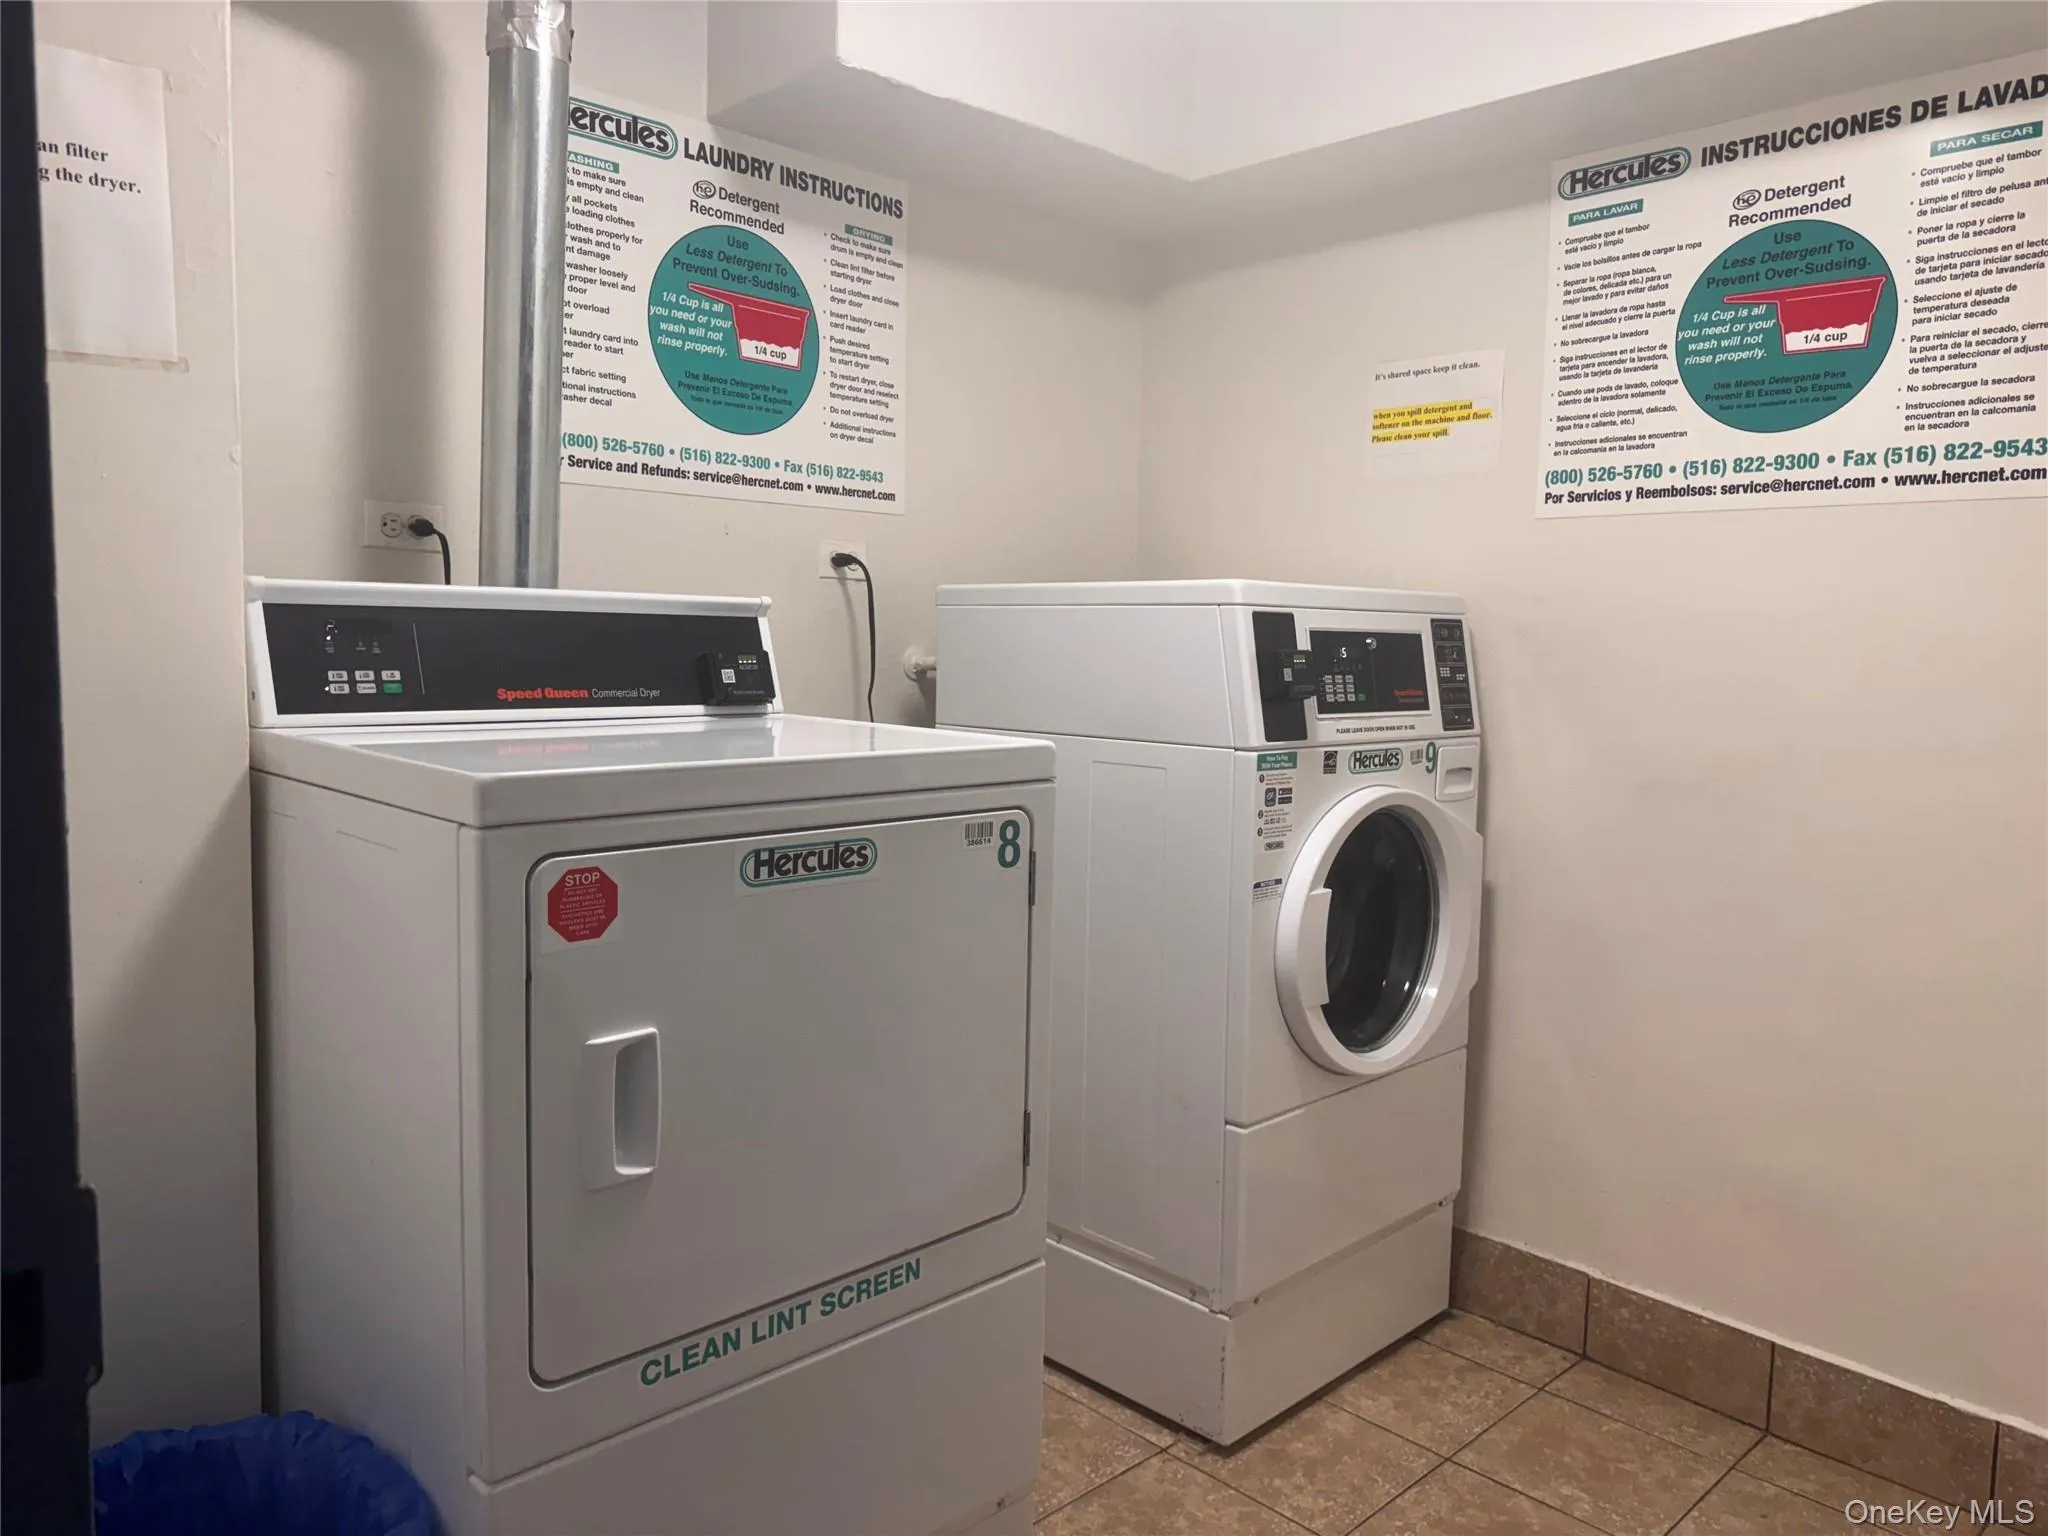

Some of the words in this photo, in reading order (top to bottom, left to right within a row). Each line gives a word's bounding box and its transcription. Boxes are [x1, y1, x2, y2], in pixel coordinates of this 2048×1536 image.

[1570, 152, 1682, 194] Hercules
[1701, 105, 1902, 167] INSTRUCCIONES
[1911, 95, 1949, 124] DE
[1957, 74, 2048, 113] LAVAD
[1937, 137, 1977, 152] PARA
[1981, 126, 2034, 143] SECAR
[65, 141, 109, 163] filter
[1920, 161, 1973, 177] Compruebe
[1975, 157, 1993, 167] que
[1996, 154, 2005, 163] el
[2007, 149, 2042, 161] tambor
[55, 167, 83, 184] the
[88, 172, 142, 194] dryer.
[685, 138, 773, 181] LAUNDRY
[780, 165, 903, 219] INSTRUCTIONS
[1765, 174, 1846, 202] Detergent
[577, 181, 603, 193] empty
[605, 187, 620, 197] and
[622, 192, 644, 203] clean
[719, 186, 780, 214] Detergent
[690, 200, 785, 235] Recommended
[1573, 210, 1601, 223] PARA
[1604, 203, 1639, 218] LAVAR
[1729, 194, 1852, 227] Recommended
[727, 235, 749, 250] Use
[1774, 231, 1802, 245] Use
[1917, 235, 1945, 247] puerta
[1948, 232, 1959, 241] de
[1962, 230, 1970, 239] la
[1972, 224, 2017, 238] secadora
[686, 243, 713, 260] Less
[717, 250, 772, 273] Detergent
[775, 263, 788, 277] To
[1722, 255, 1756, 270] Less
[1760, 241, 1832, 265] Detergent
[1837, 239, 1855, 252] To
[673, 257, 718, 279] Prevent
[721, 268, 800, 298] Over-Sudsing.
[1706, 271, 1761, 289] Prevent
[1765, 255, 1872, 281] Over-Sudsing.
[662, 291, 676, 304] 1/4
[679, 294, 699, 310] Cup
[702, 299, 710, 311] is
[712, 301, 724, 313] all
[1693, 312, 1708, 323] 1/4
[1712, 310, 1735, 322] Cup
[1738, 307, 1748, 318] is
[1751, 304, 1766, 315] all
[650, 305, 669, 316] you
[671, 306, 695, 321] need
[698, 313, 708, 323] or
[710, 316, 732, 329] your
[660, 321, 686, 335] wash
[688, 326, 705, 338] will
[708, 330, 723, 342] not
[1678, 329, 1699, 341] you
[1701, 323, 1730, 336] need
[1732, 322, 1744, 332] or
[1748, 318, 1776, 331] your
[1803, 333, 1821, 345] 1/4
[1825, 331, 1848, 343] cup
[657, 335, 683, 348] rinse
[684, 340, 728, 358] properly.
[754, 345, 768, 357] 1/4
[770, 350, 787, 361] cup
[1688, 338, 1718, 351] wash
[1721, 335, 1741, 348] will
[1743, 333, 1764, 345] not
[1684, 352, 1713, 366] rinse
[1715, 348, 1768, 364] properly.
[1375, 373, 1387, 381] It's
[1387, 370, 1411, 380] shared
[1412, 368, 1431, 379] space
[1433, 364, 1450, 375] keep
[1459, 361, 1480, 370] clean.
[1906, 384, 1919, 393] No
[1921, 379, 1978, 393] sobrecargue
[1980, 377, 1992, 386] la
[1994, 374, 2036, 386] secadora
[1372, 420, 1400, 430] softener
[1401, 420, 1410, 428] on
[1412, 418, 1423, 426] the
[1424, 415, 1455, 426] machine
[1457, 413, 1471, 422] and
[1472, 411, 1493, 421] floor.
[1373, 411, 1391, 420] when
[1393, 411, 1406, 421] you
[1407, 408, 1422, 419] spill
[1423, 404, 1457, 416] detergent
[1459, 402, 1473, 411] and
[1371, 434, 1393, 444] Please
[1394, 432, 1412, 441] clean
[1413, 431, 1430, 441] your
[1432, 428, 1450, 439] spill.
[562, 432, 598, 454] (800)
[602, 437, 664, 457] 526-5760
[679, 447, 712, 465] (516)
[715, 451, 770, 470] 822-9300
[784, 460, 803, 474] Fax
[806, 462, 834, 479] (516)
[836, 466, 884, 483] 822-9543
[1545, 468, 1583, 488] (800)
[1587, 463, 1663, 483] 526-5760
[1683, 459, 1727, 480] (516)
[1732, 453, 1820, 474] 822-9300
[1843, 449, 1877, 467] Fax
[1884, 444, 1937, 468] (516)
[1943, 437, 2048, 461] 822-9543
[567, 456, 612, 472] Service
[616, 461, 638, 475] and
[641, 464, 690, 481] Refunds:
[693, 469, 804, 492] service@hercnet.com
[815, 482, 896, 503] www.hercnet.com
[1545, 492, 1563, 505] Por
[1567, 489, 1622, 504] Servicios
[1626, 489, 1633, 502] y
[1636, 484, 1718, 500] Reembolsos:
[1720, 475, 1875, 495] service@hercnet.com
[1894, 466, 2047, 487] www.hercnet.com
[497, 688, 542, 702] Speed
[545, 687, 589, 700] Queen
[592, 687, 638, 700] Commercial
[640, 687, 661, 701] Dryer
[1353, 751, 1400, 769] Hercules
[1425, 741, 1437, 774] 9
[998, 819, 1021, 869] 8
[752, 844, 869, 880] Hercules
[564, 871, 600, 887] STOP
[640, 1327, 741, 1386] CLEAN
[751, 1300, 812, 1345] LINT
[820, 1257, 921, 1317] SCREEN
